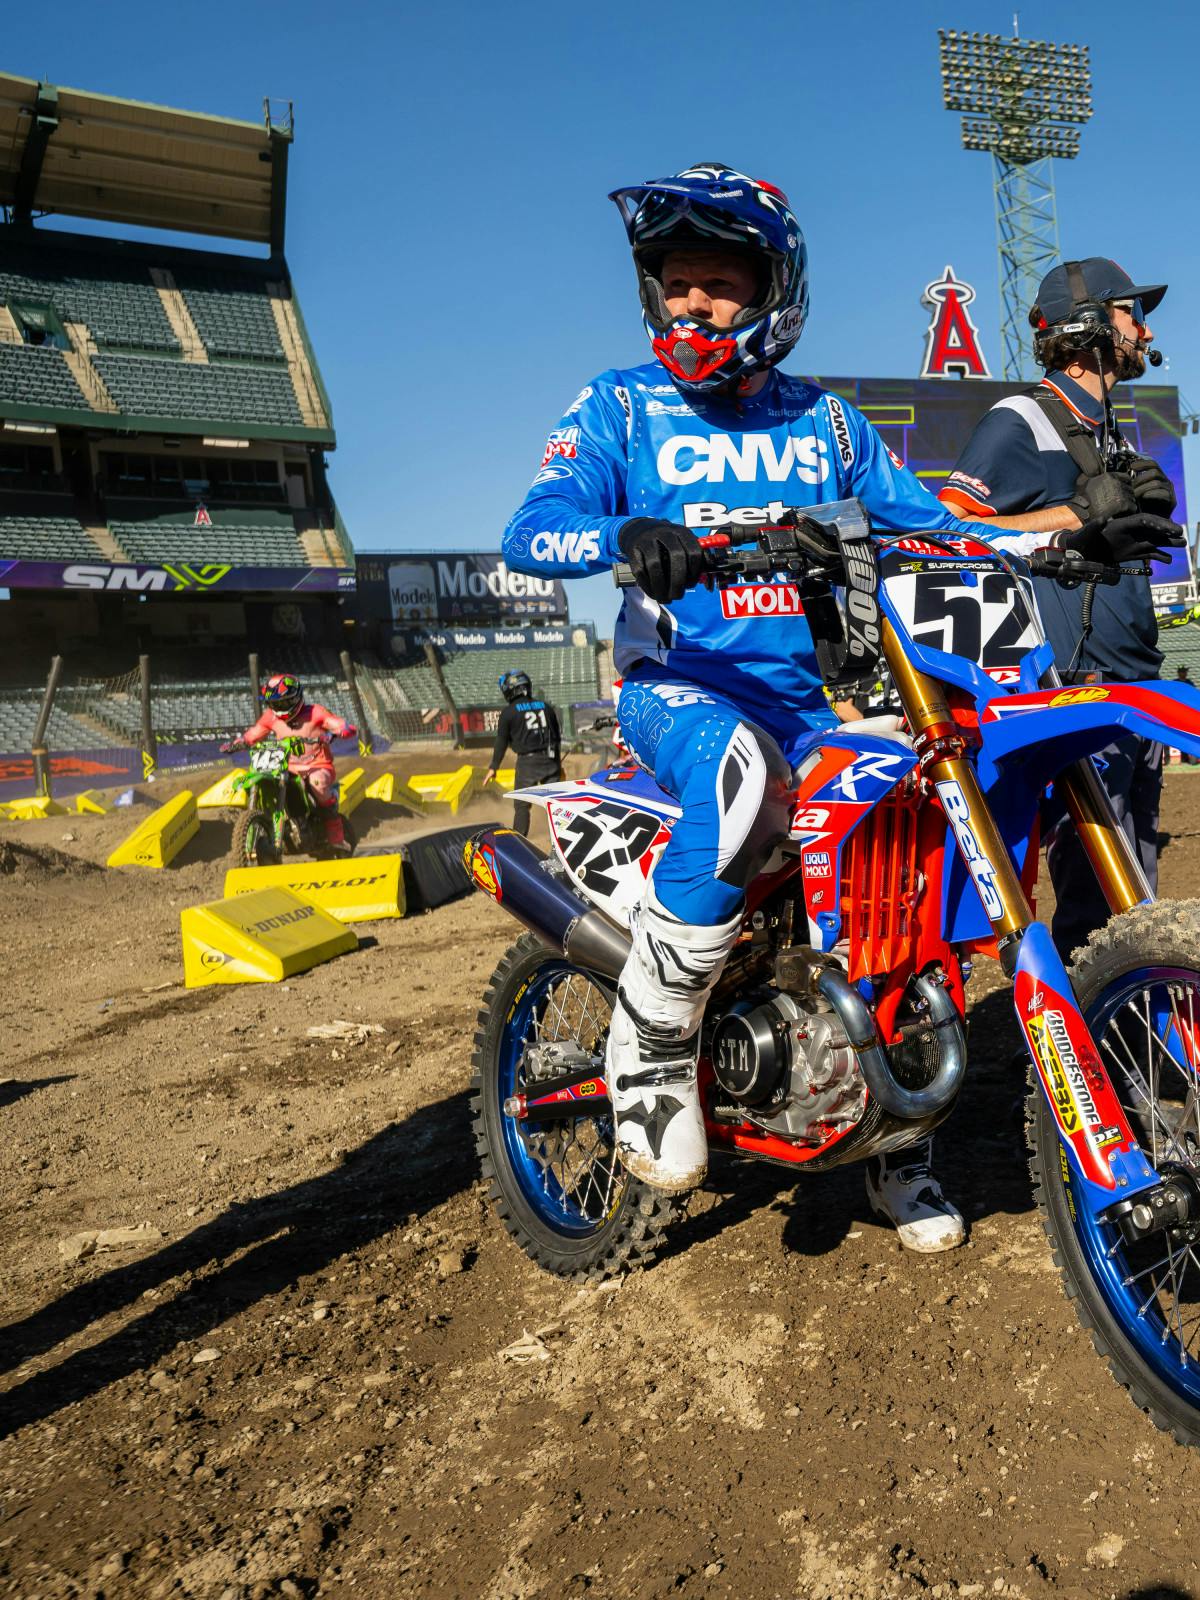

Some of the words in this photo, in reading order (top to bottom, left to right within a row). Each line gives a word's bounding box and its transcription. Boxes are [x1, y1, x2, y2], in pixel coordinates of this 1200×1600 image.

[921, 265, 992, 379] A
[829, 398, 853, 463] CANVAS
[656, 433, 830, 486] CNVS
[949, 471, 991, 497] Beta
[683, 501, 792, 528] Bet
[530, 530, 600, 563] CNVS
[928, 562, 995, 570] SUPERCROSS
[391, 587, 436, 607] Modelo
[912, 572, 1034, 669] 52
[454, 633, 487, 646] Modelo
[495, 632, 526, 644] Modelo
[534, 630, 564, 643] Modelo
[525, 712, 547, 731] 21
[251, 750, 285, 771] 142
[805, 853, 828, 865] LIQUI
[936, 780, 1003, 921] Beta
[805, 865, 829, 877] MOLY
[255, 905, 316, 933] DUNLOP
[718, 1038, 750, 1073] STM
[1043, 1010, 1103, 1125] BRIDGESTONE
[1028, 1022, 1079, 1136] ACERBIS
